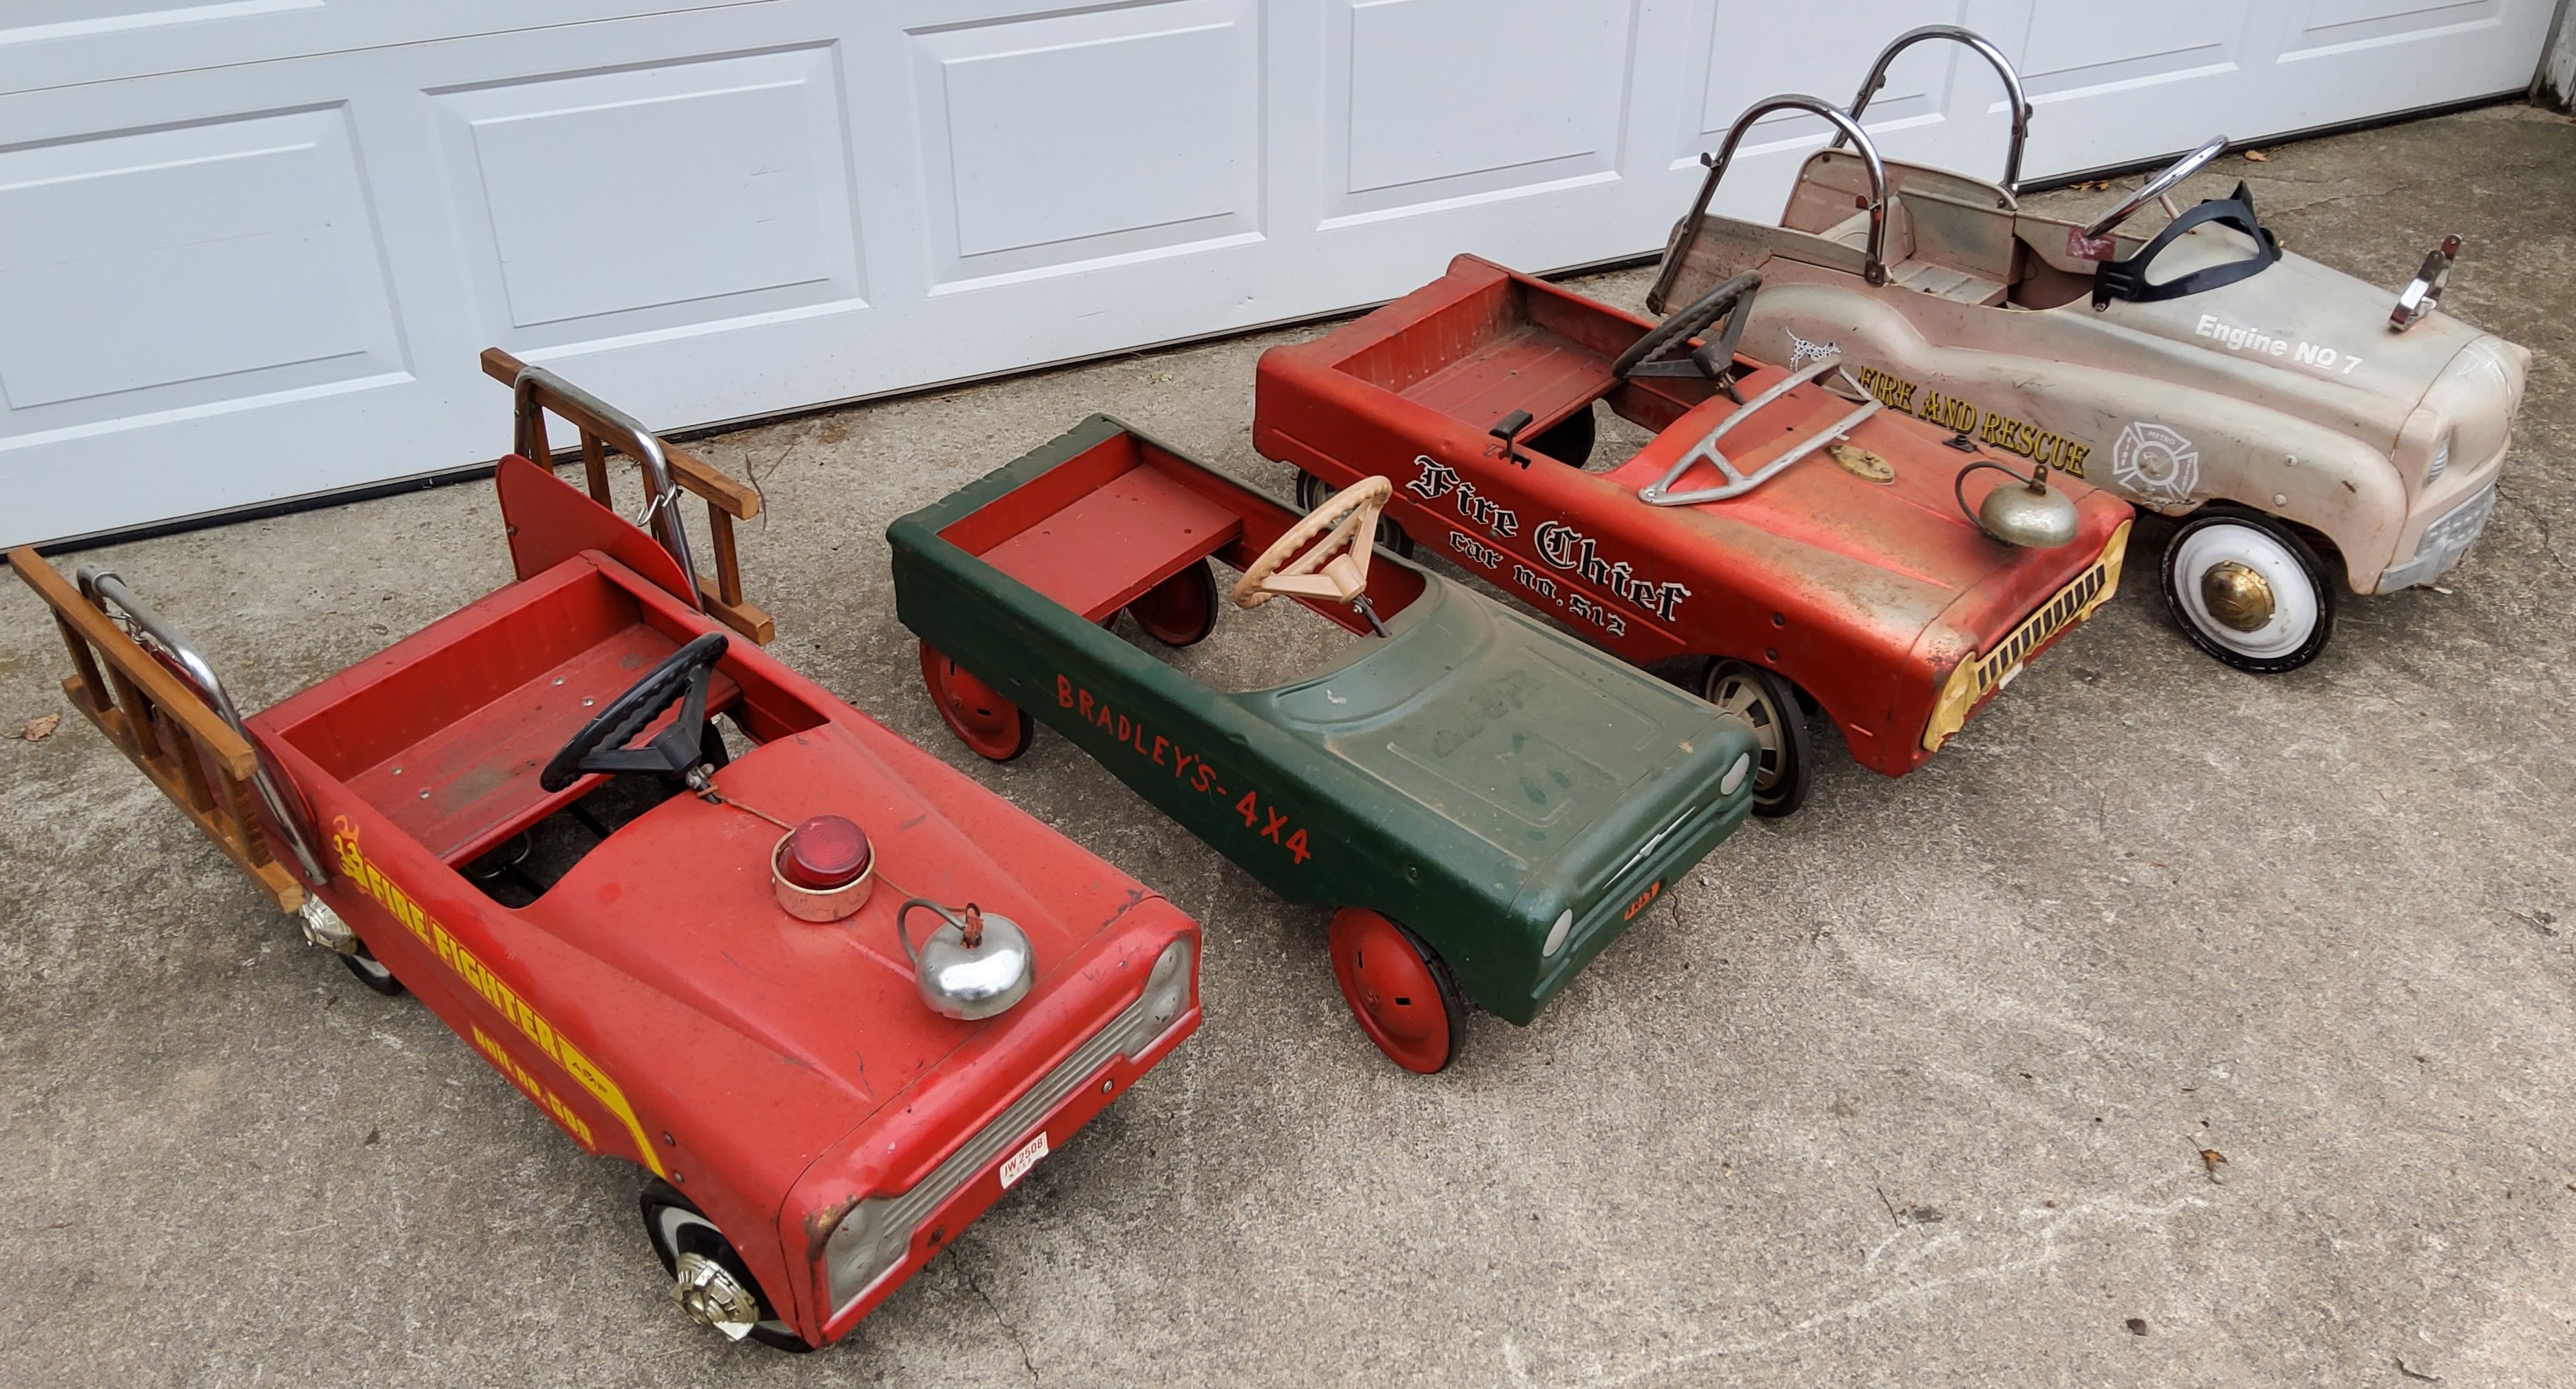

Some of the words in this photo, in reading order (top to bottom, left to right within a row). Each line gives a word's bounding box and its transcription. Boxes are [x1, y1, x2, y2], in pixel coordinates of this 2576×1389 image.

[2195, 314, 2287, 356] Engine
[2343, 355, 2363, 374] 7
[1858, 364, 1917, 414] FIRE
[1918, 389, 1977, 435] AND
[1980, 411, 2090, 479] RESCUE
[2148, 431, 2175, 445] METRO
[1405, 455, 1518, 537] Fire
[1534, 521, 1692, 622] Chief
[1449, 531, 1504, 570] car
[366, 863, 431, 945] FIRE
[432, 922, 561, 1063] FIGHTER
[1005, 1158, 1017, 1177] JW
[1019, 1138, 1043, 1164] 2508
